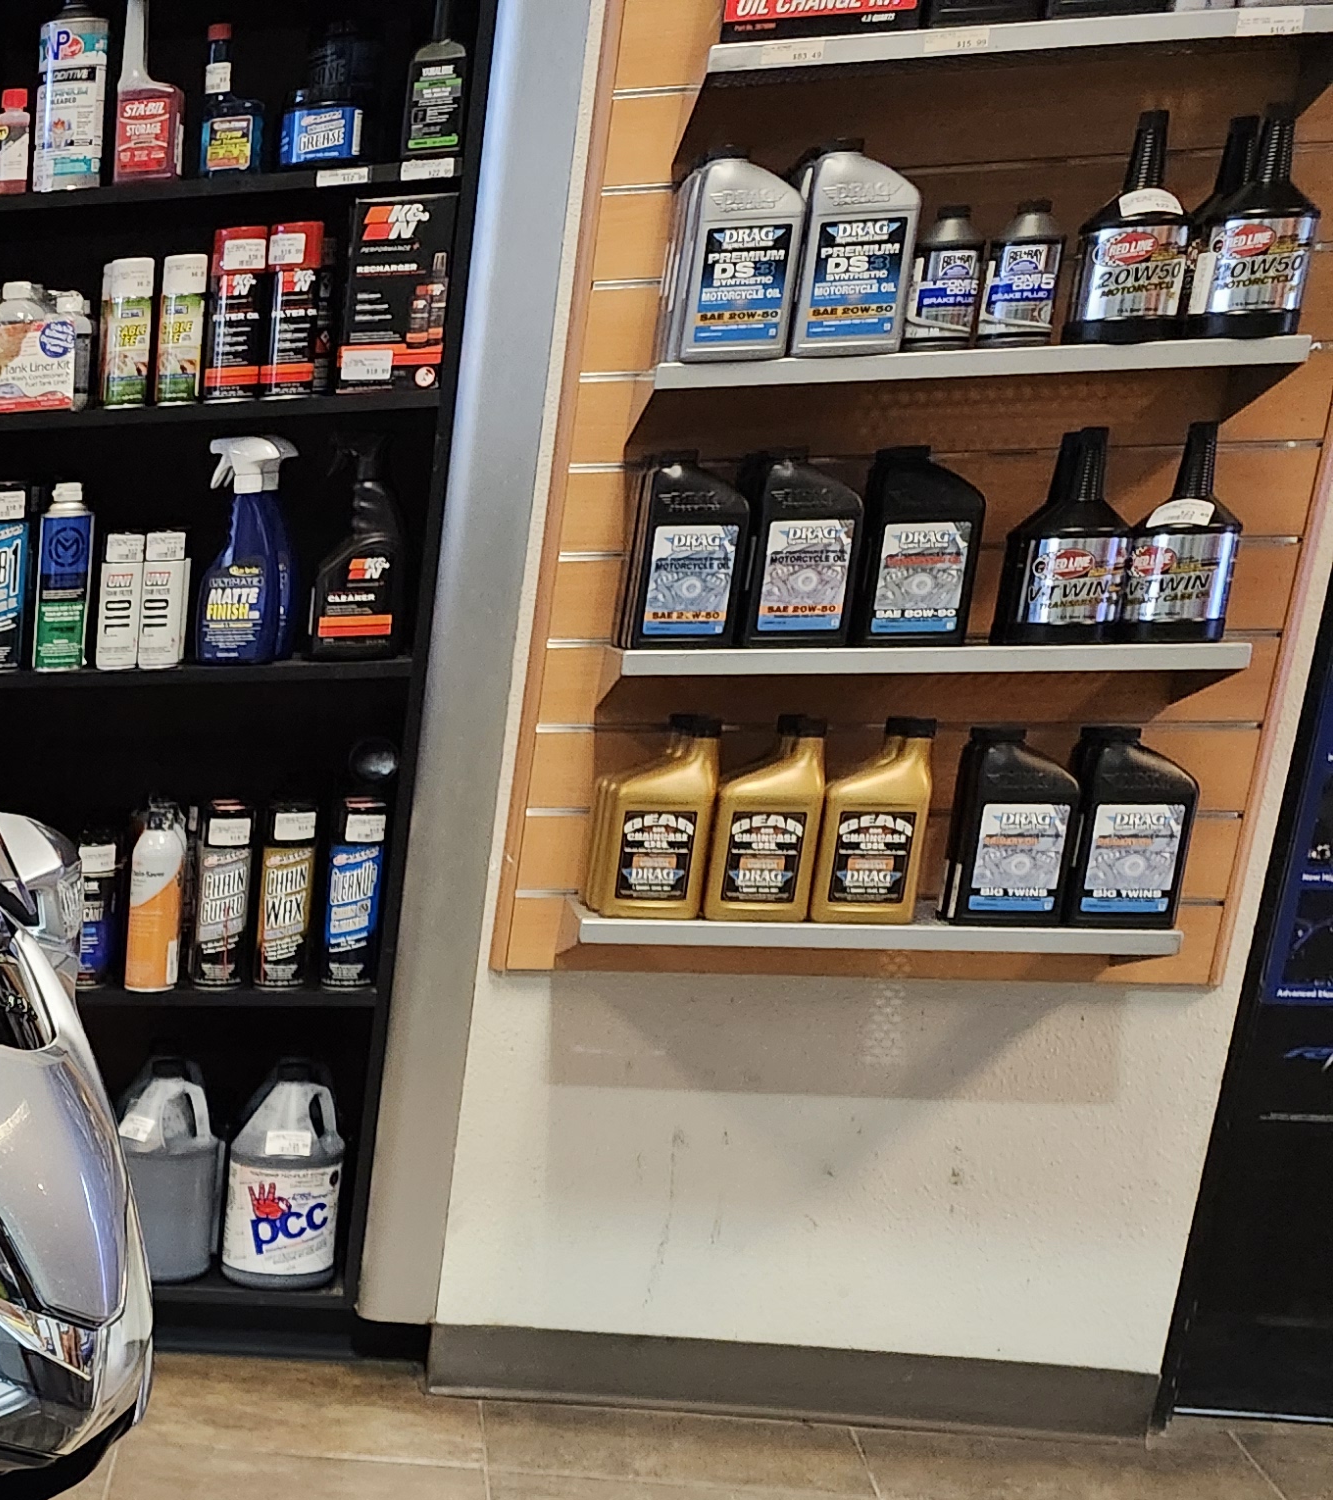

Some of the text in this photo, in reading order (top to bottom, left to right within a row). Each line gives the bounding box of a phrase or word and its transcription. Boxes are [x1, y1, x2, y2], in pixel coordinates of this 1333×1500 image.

[735, 0, 770, 17] OIL
[126, 122, 162, 135] STORAGE
[299, 127, 345, 153] GREASE
[724, 227, 774, 243] DRAG
[837, 220, 889, 237] DRAG
[1225, 231, 1272, 249] RED LINE
[820, 243, 900, 259] PREMIUM
[1109, 240, 1155, 256] RED LINE
[708, 250, 785, 264] PREMIUM
[356, 263, 418, 274] RECHARGER
[713, 261, 775, 279] DS3
[827, 255, 890, 274] DS3
[713, 276, 773, 286] SYNTHETIC
[826, 270, 888, 282] SYNTHETIC
[1012, 273, 1056, 291] DOT 5
[1098, 261, 1182, 289] 20W50
[702, 286, 782, 301] MOTORCYCLE OIL
[814, 282, 896, 296] MOTORCYCLE OIL
[991, 290, 1048, 301] BRAKE FLUID
[923, 296, 954, 306] BRAKE
[699, 310, 779, 322] SAE 20W-50
[812, 304, 894, 317] SAE 20W-50
[4, 360, 70, 375] Tank Liner Kit
[673, 534, 720, 548] DRAG
[787, 527, 836, 541] DRAG
[900, 530, 950, 545] DRAG
[655, 560, 731, 571] MOTORCYCLE OIL
[770, 553, 847, 565] MOTORCYCLE OIL
[1071, 555, 1093, 569] LINE
[107, 574, 133, 587] UNI
[145, 572, 171, 586] UNI
[209, 577, 264, 588] ULTIMATE
[1128, 573, 1209, 595] V-TWIN
[209, 588, 259, 604] MATTE
[327, 593, 376, 603] CLEANER
[1028, 580, 1110, 604] V-TWIN
[1163, 593, 1189, 603] CASE
[206, 603, 249, 621] FINISH
[767, 604, 836, 613] SAE 20W-50
[876, 609, 900, 618] SAE
[652, 612, 674, 620] SAE
[624, 813, 695, 837] GEAR
[732, 813, 803, 837] GEAR
[839, 813, 913, 837] GEAR
[1001, 812, 1051, 827] DRAG
[1115, 812, 1166, 828] DRAG
[626, 832, 689, 842] CHAINCASE
[734, 833, 797, 843] CHAINCASE
[842, 833, 906, 843] CHAINCASE
[266, 861, 309, 896] CHAIN
[632, 868, 676, 882] DRAG
[738, 869, 783, 882] DRAG
[846, 870, 891, 882] DRAG
[203, 866, 247, 900] CHAIN
[980, 888, 1048, 897] BIG TWINS
[1093, 889, 1162, 898] BIG TWINS
[201, 893, 245, 926] GUARD
[266, 891, 307, 930] WAX
[1277, 988, 1317, 999] Advanced
[250, 1202, 329, 1256] pcc
